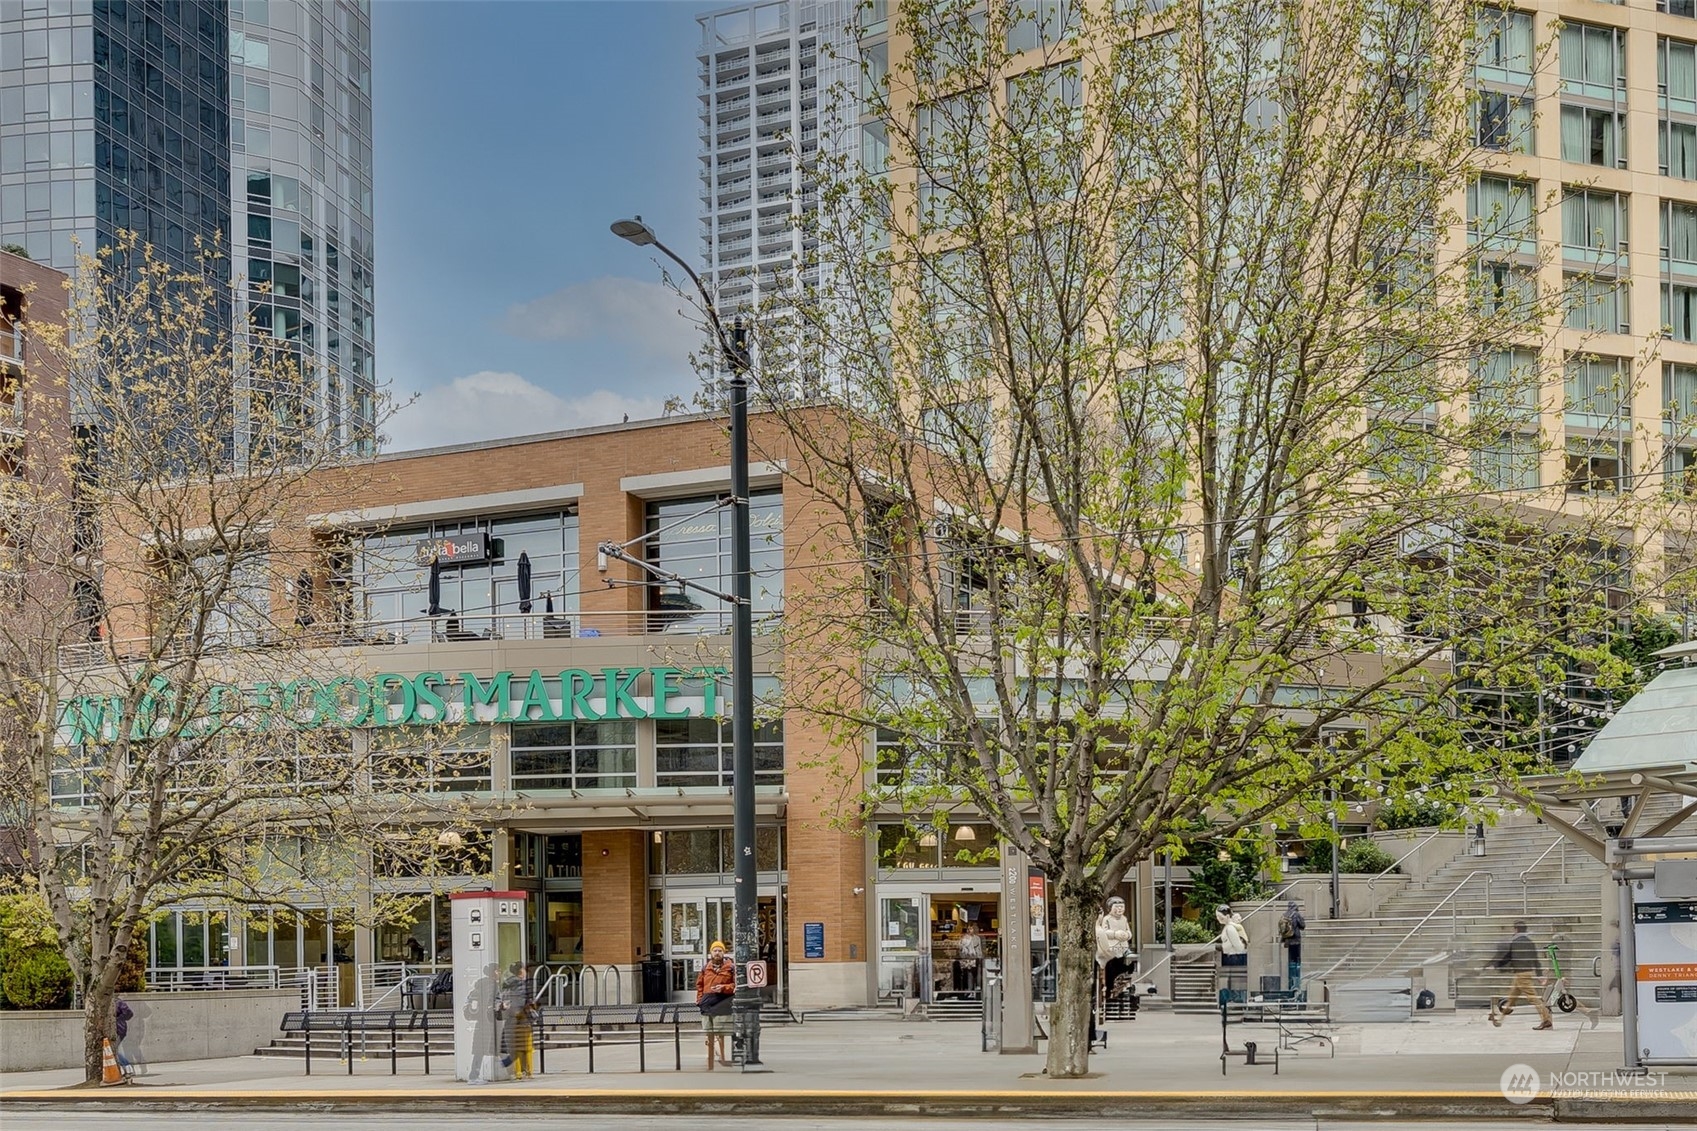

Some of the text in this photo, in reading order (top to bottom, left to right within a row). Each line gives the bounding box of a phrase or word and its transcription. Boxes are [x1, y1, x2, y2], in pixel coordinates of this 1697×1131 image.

[452, 541, 479, 555] bella
[459, 667, 728, 724] MARKET
[1010, 888, 1018, 949] WESTLAKE
